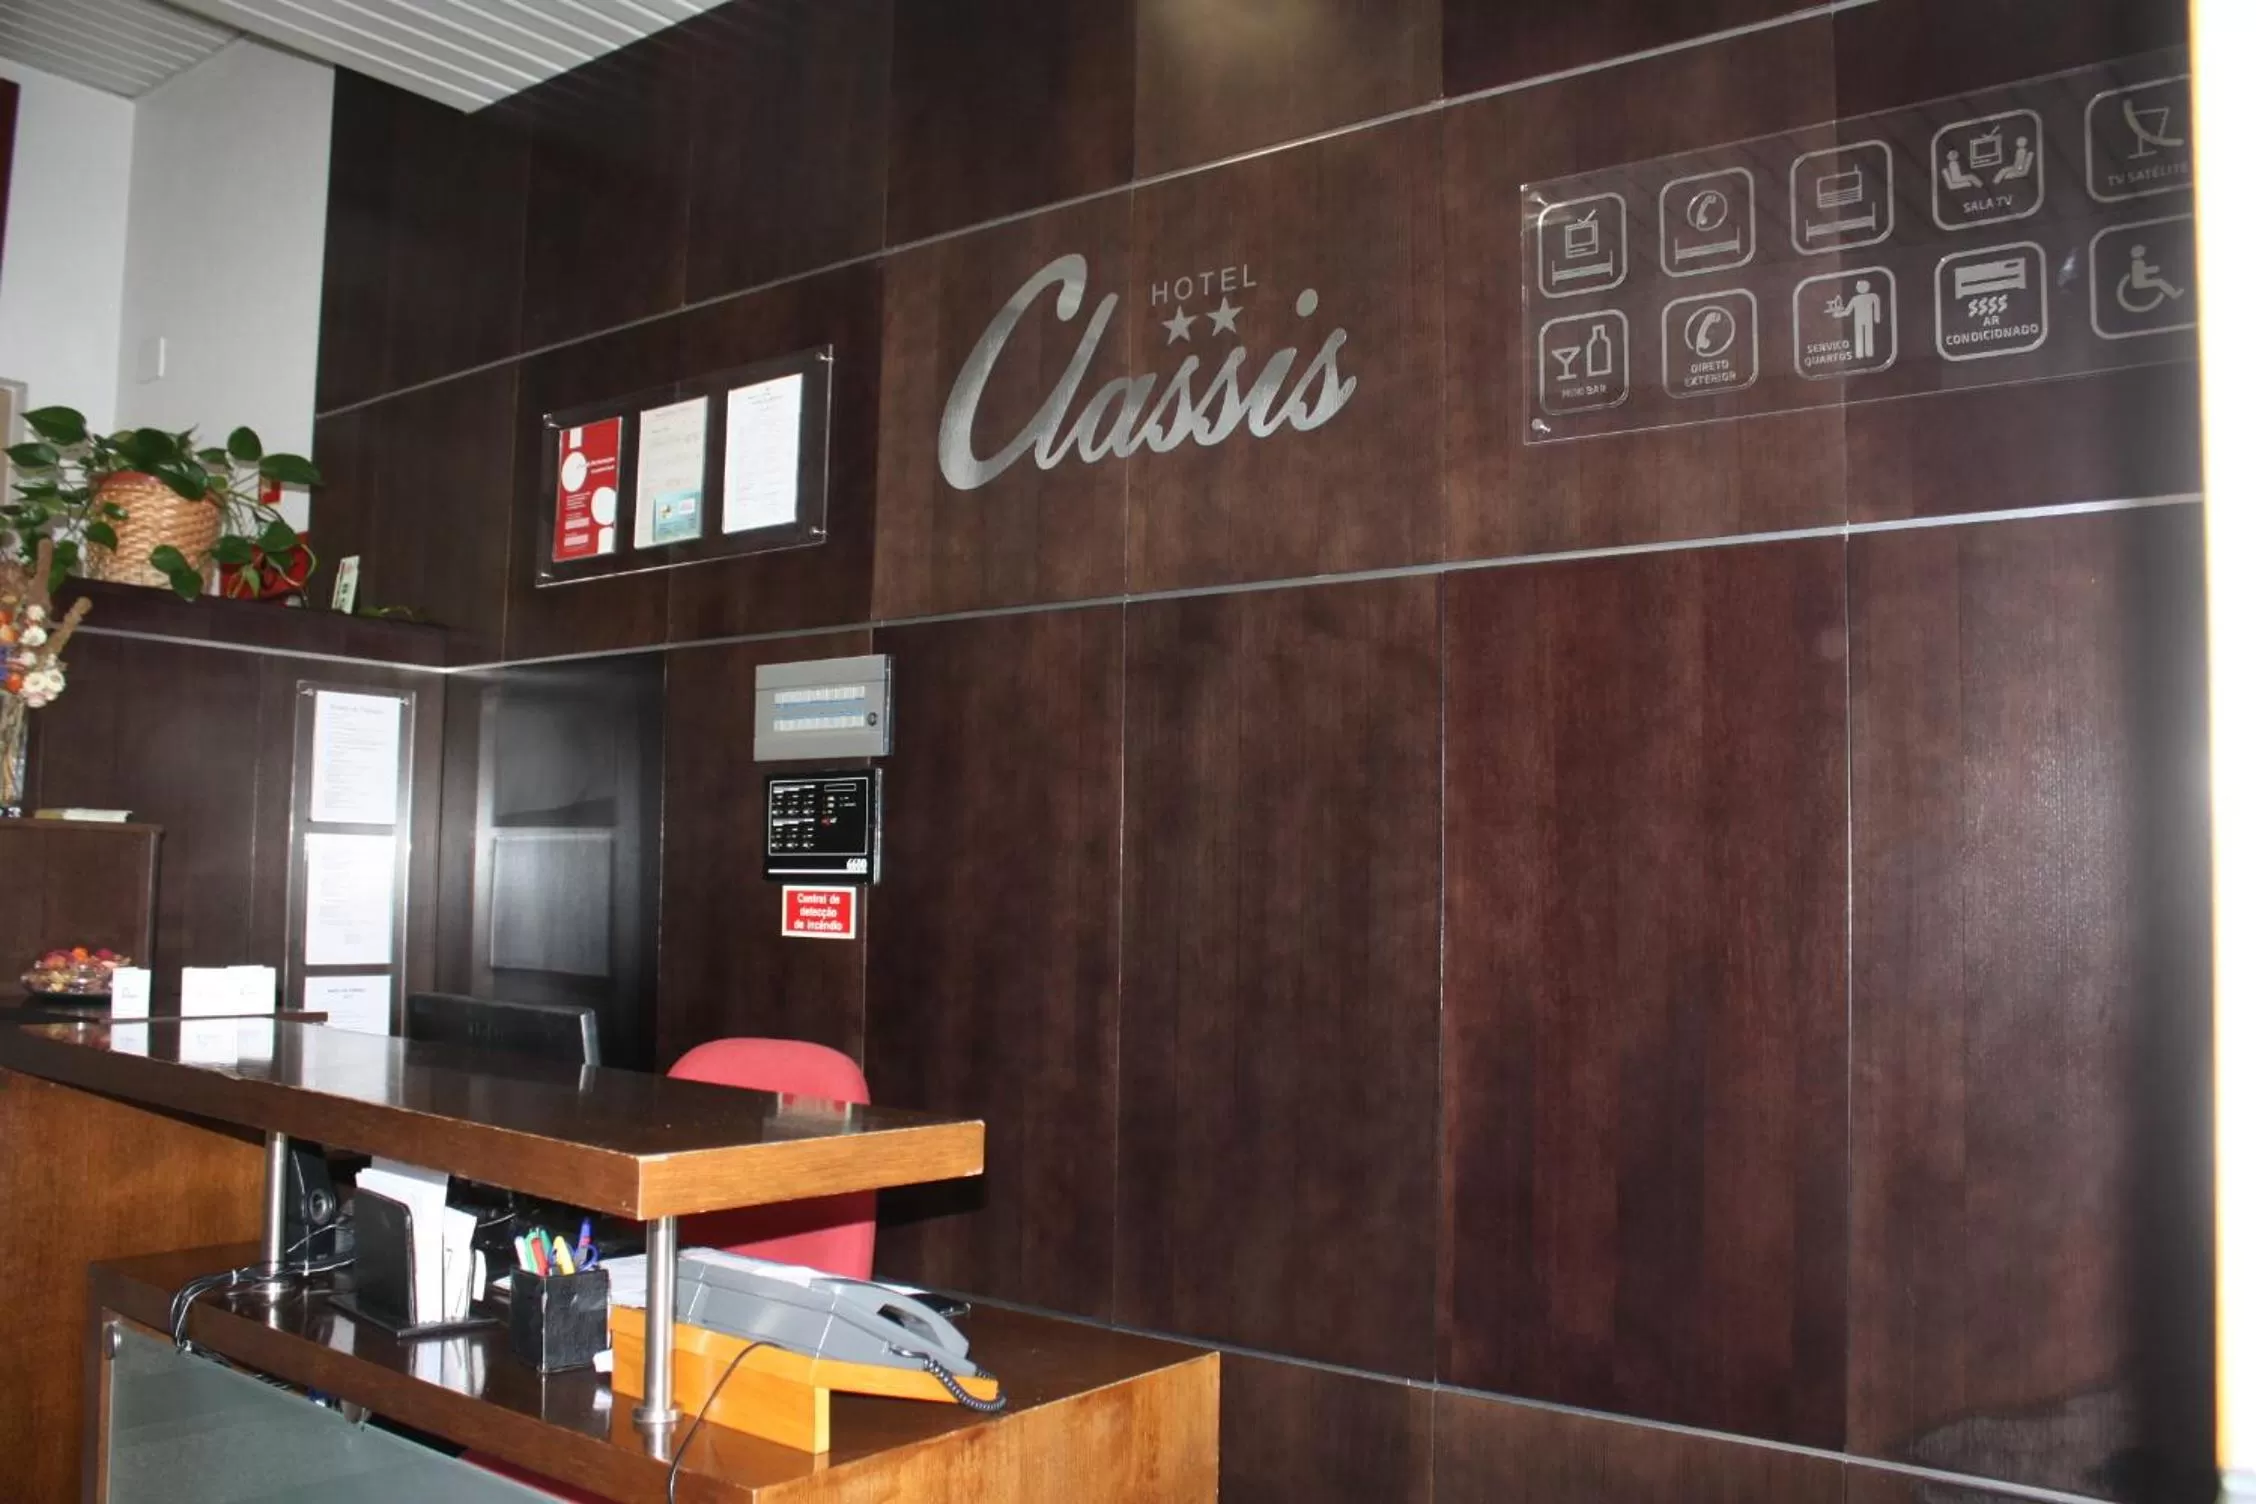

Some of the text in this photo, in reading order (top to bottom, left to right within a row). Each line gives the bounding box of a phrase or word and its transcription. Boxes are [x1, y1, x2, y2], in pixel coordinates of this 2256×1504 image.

[2108, 171, 2124, 187] TV
[1963, 193, 2014, 213] SALA TV
[1152, 264, 1257, 306] HOTEL
[1983, 316, 2000, 327] AR
[1946, 324, 2039, 345] CONDICIONADO
[938, 253, 1358, 491] Classis
[1690, 359, 1729, 374] DIRETO
[1684, 370, 1737, 387] EXTERIOR
[1586, 384, 1607, 396] BAR
[796, 892, 841, 905] Central de
[793, 919, 805, 930] de
